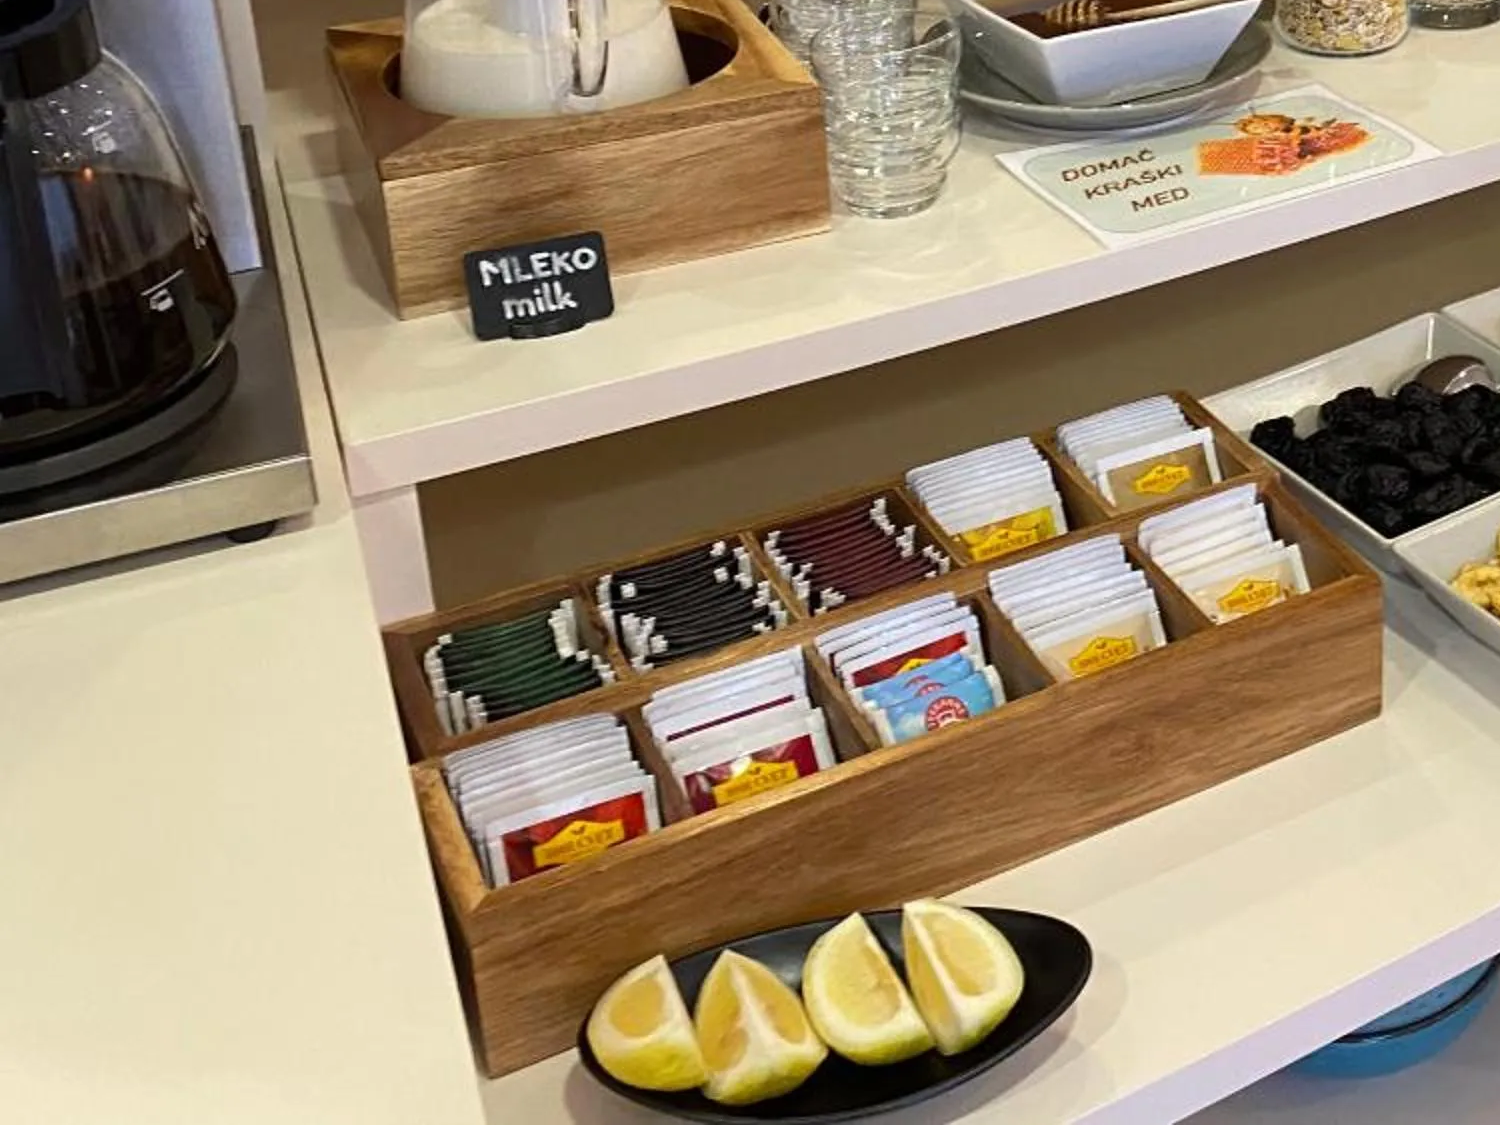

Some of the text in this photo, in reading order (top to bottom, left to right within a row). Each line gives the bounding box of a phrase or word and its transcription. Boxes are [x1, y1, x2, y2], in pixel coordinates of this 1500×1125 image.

[1060, 148, 1157, 183] DOMAČ
[1084, 163, 1184, 200] KRAŠKI
[1130, 186, 1190, 213] MED
[479, 246, 598, 287] MLEKO
[502, 280, 579, 320] milk
